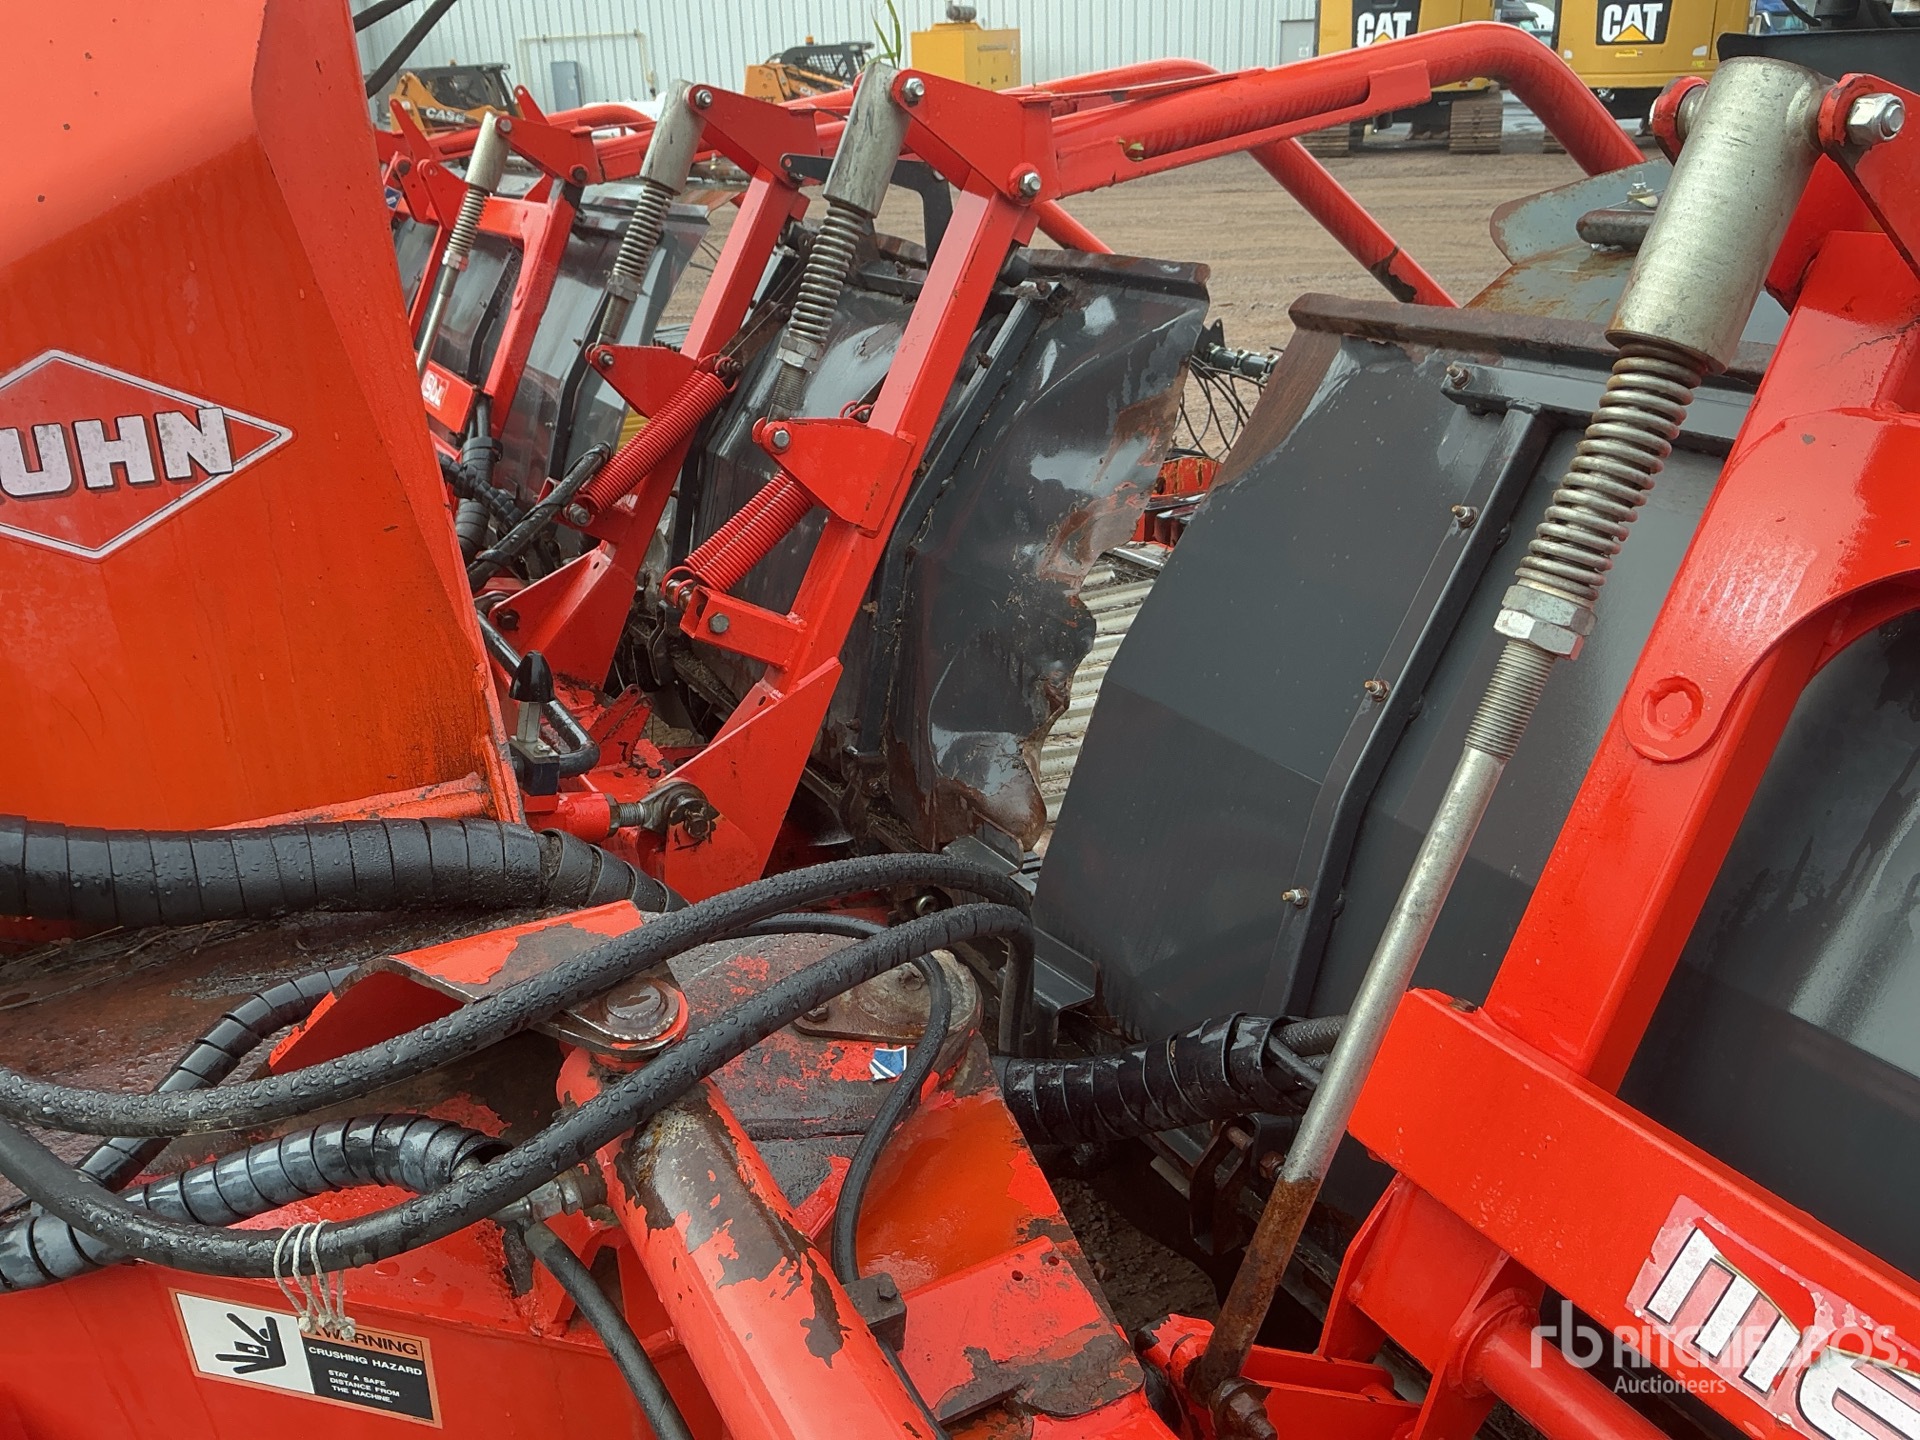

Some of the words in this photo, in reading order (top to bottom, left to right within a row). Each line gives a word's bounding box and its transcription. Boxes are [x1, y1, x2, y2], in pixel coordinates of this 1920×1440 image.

[1357, 12, 1412, 48] CAT
[1602, 3, 1663, 42] CAT
[0, 407, 234, 497] UHN
[322, 1326, 419, 1356] WRNING
[308, 1346, 369, 1365] CRUSHING
[372, 1359, 423, 1376] HAZARD
[328, 1369, 349, 1379] STAY
[363, 1375, 387, 1387] SAFE
[329, 1377, 371, 1391] DISTANCE
[374, 1386, 400, 1397] FROM
[331, 1385, 349, 1394] THE
[352, 1389, 393, 1403] MACHINE.
